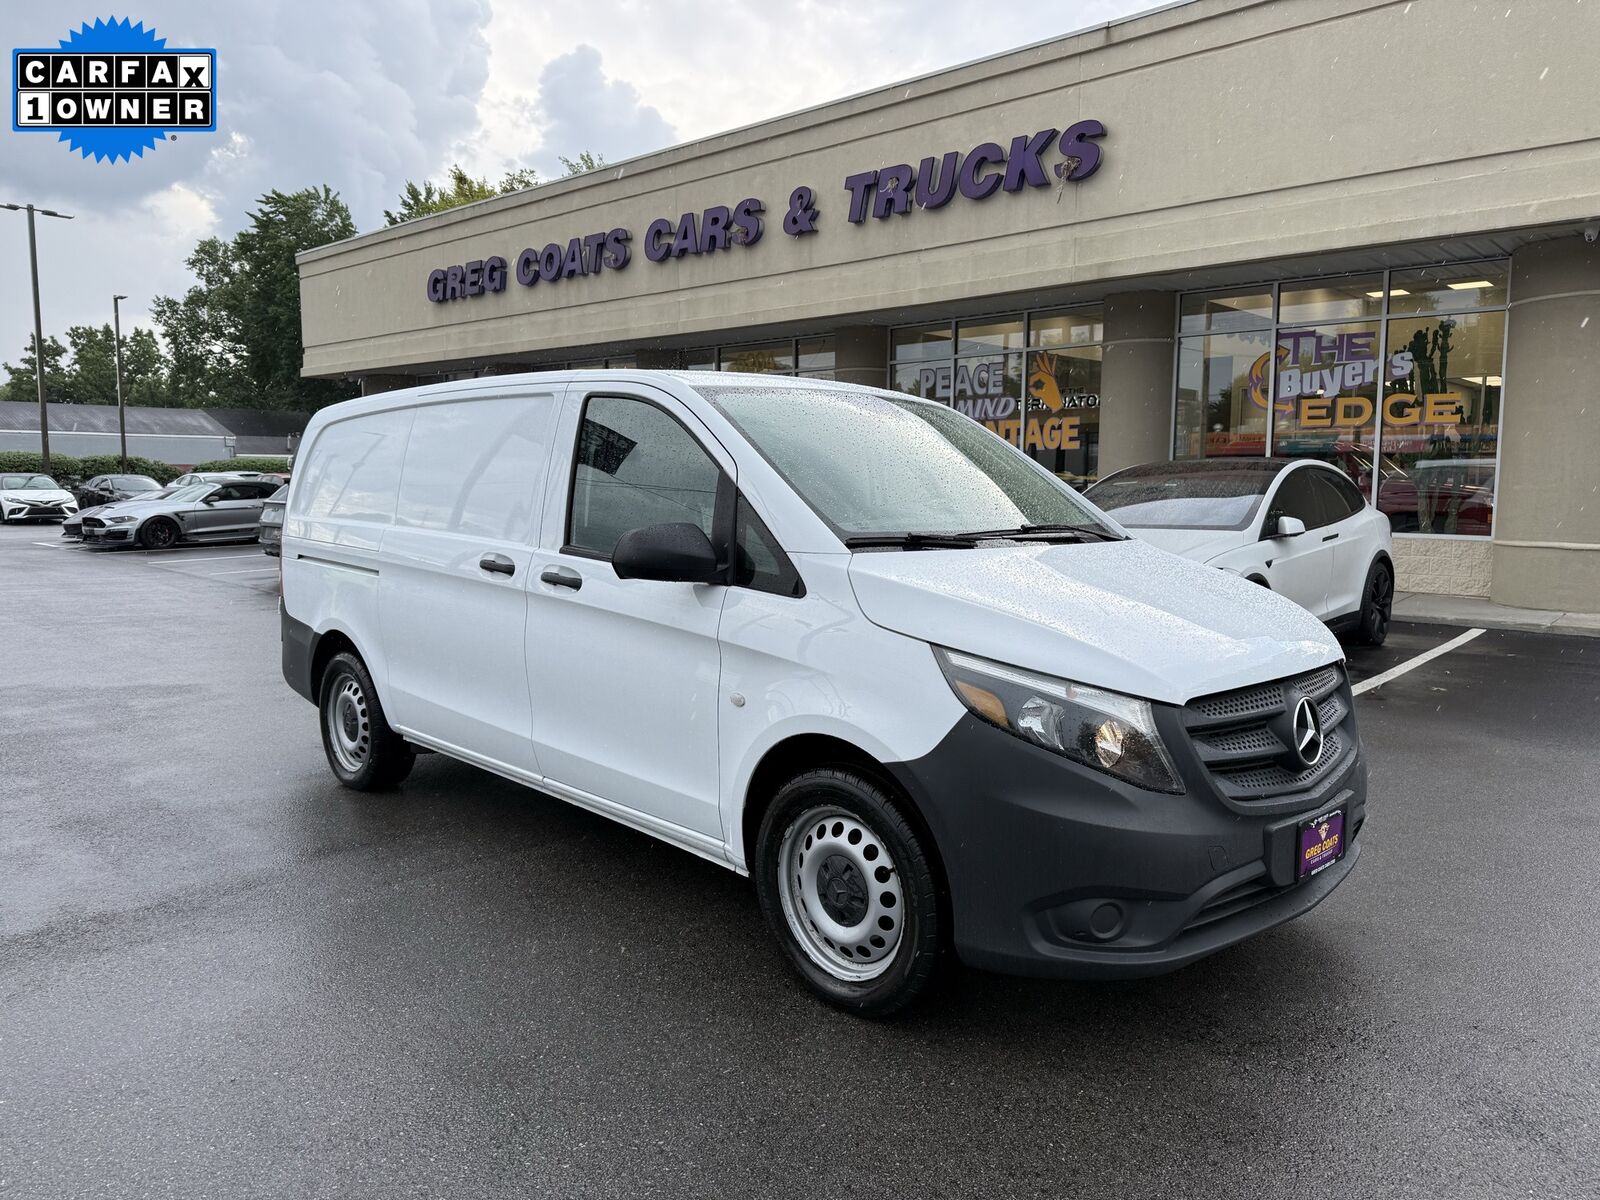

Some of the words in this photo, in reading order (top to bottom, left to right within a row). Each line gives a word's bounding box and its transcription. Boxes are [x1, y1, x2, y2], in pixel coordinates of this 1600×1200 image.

[427, 256, 508, 303] GREG
[516, 228, 632, 287] COATS
[644, 198, 766, 262] CARS
[783, 185, 820, 236] &
[844, 119, 1108, 224] TRUCKS
[1279, 331, 1376, 366] THE
[920, 362, 1004, 399] PEACE
[1279, 351, 1414, 399] Buyer's
[956, 397, 1016, 420] MIND
[1300, 391, 1462, 429] EDGE
[1305, 844, 1321, 859] GREG
